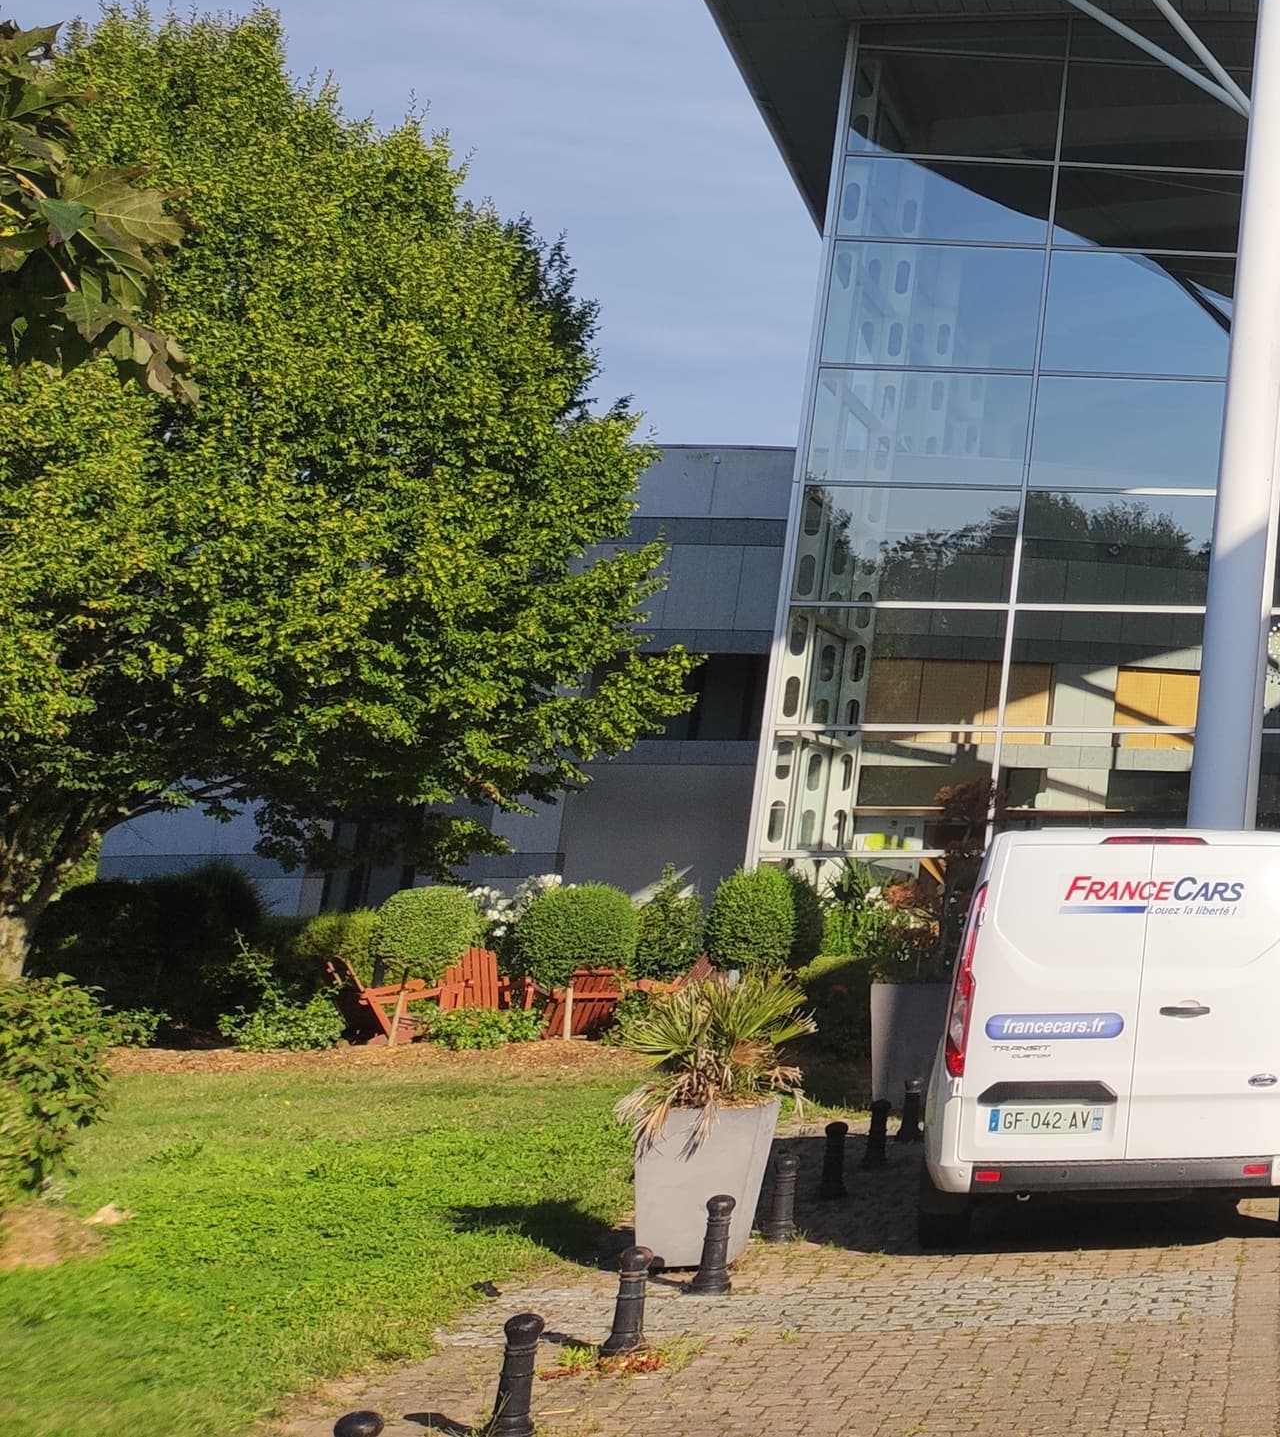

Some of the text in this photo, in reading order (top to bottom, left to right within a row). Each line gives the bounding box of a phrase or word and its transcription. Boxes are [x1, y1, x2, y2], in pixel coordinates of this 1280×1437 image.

[1149, 906, 1180, 915] Louez
[1183, 905, 1193, 915] la
[1002, 1018, 1106, 1034] francecars.fr
[991, 1044, 1052, 1052] TRANSIT
